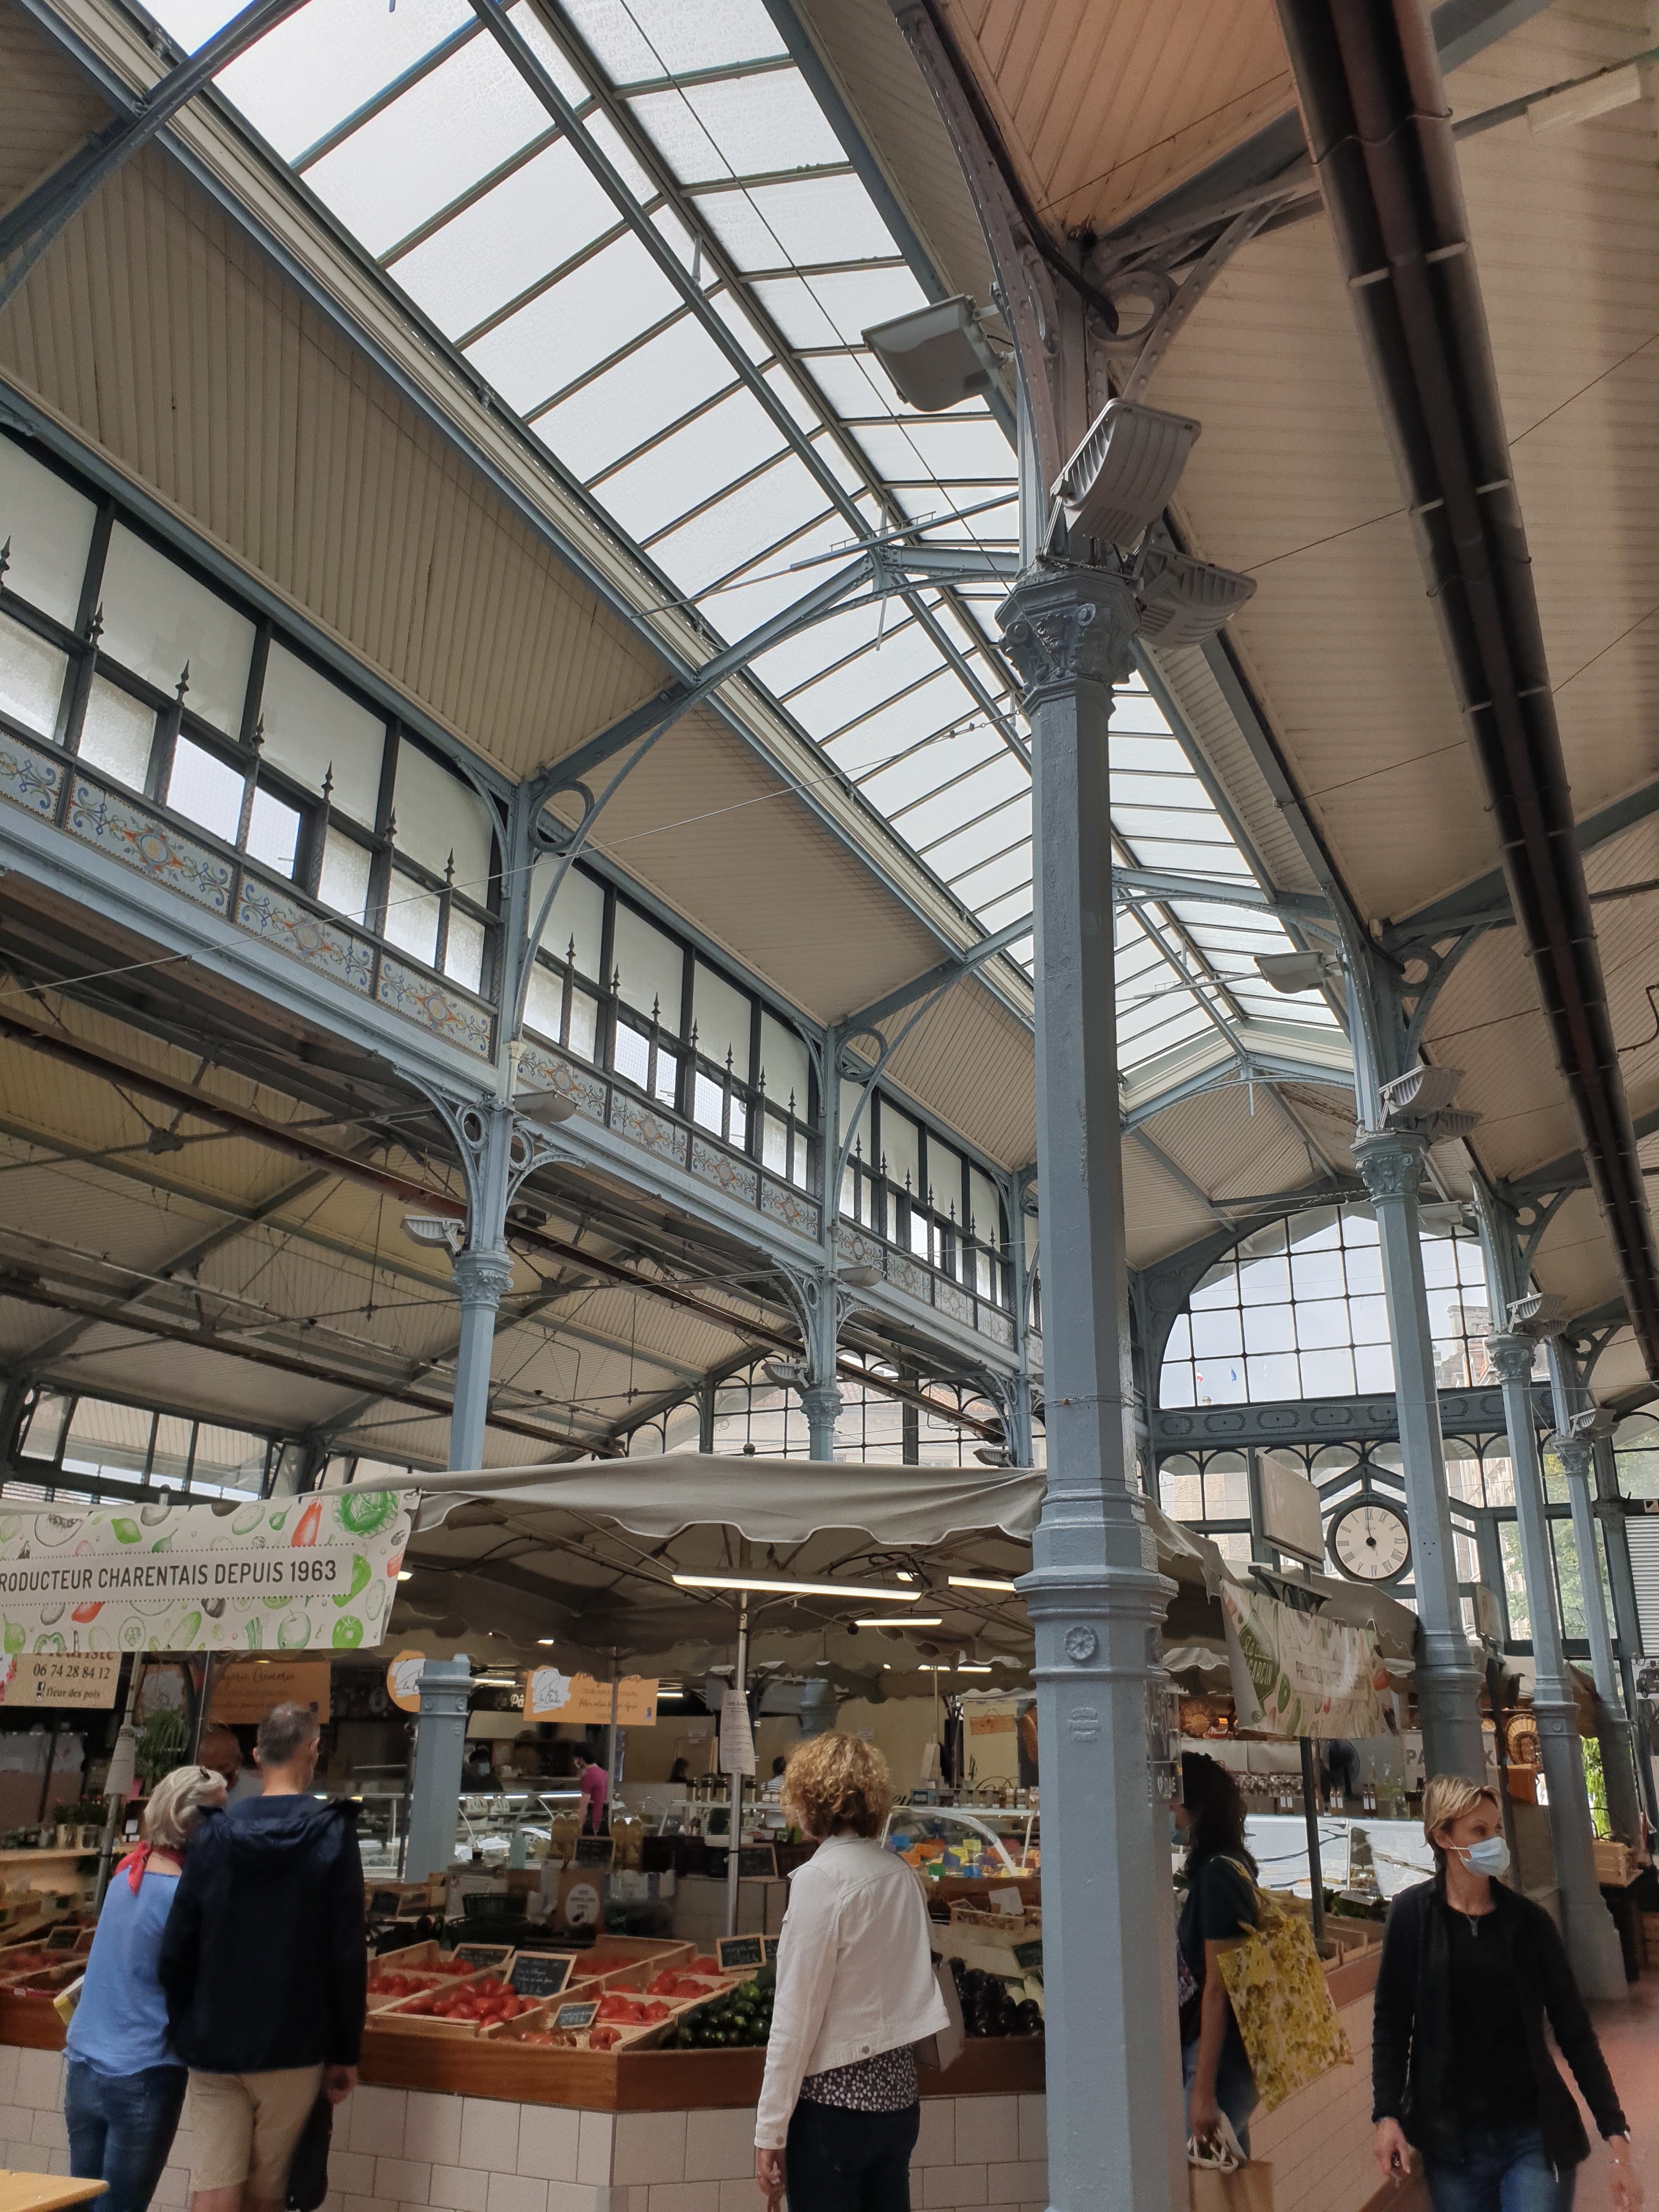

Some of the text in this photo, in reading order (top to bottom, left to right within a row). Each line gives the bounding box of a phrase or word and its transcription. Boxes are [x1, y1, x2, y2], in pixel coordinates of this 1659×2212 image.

[98, 1564, 208, 1588] CHARENTAIS
[215, 1561, 284, 1584] DEPUIS
[290, 1559, 336, 1582] 1963
[33, 1663, 110, 1680] 06 74 28 84 12
[68, 1688, 82, 1699] des
[83, 1689, 100, 1700] pois
